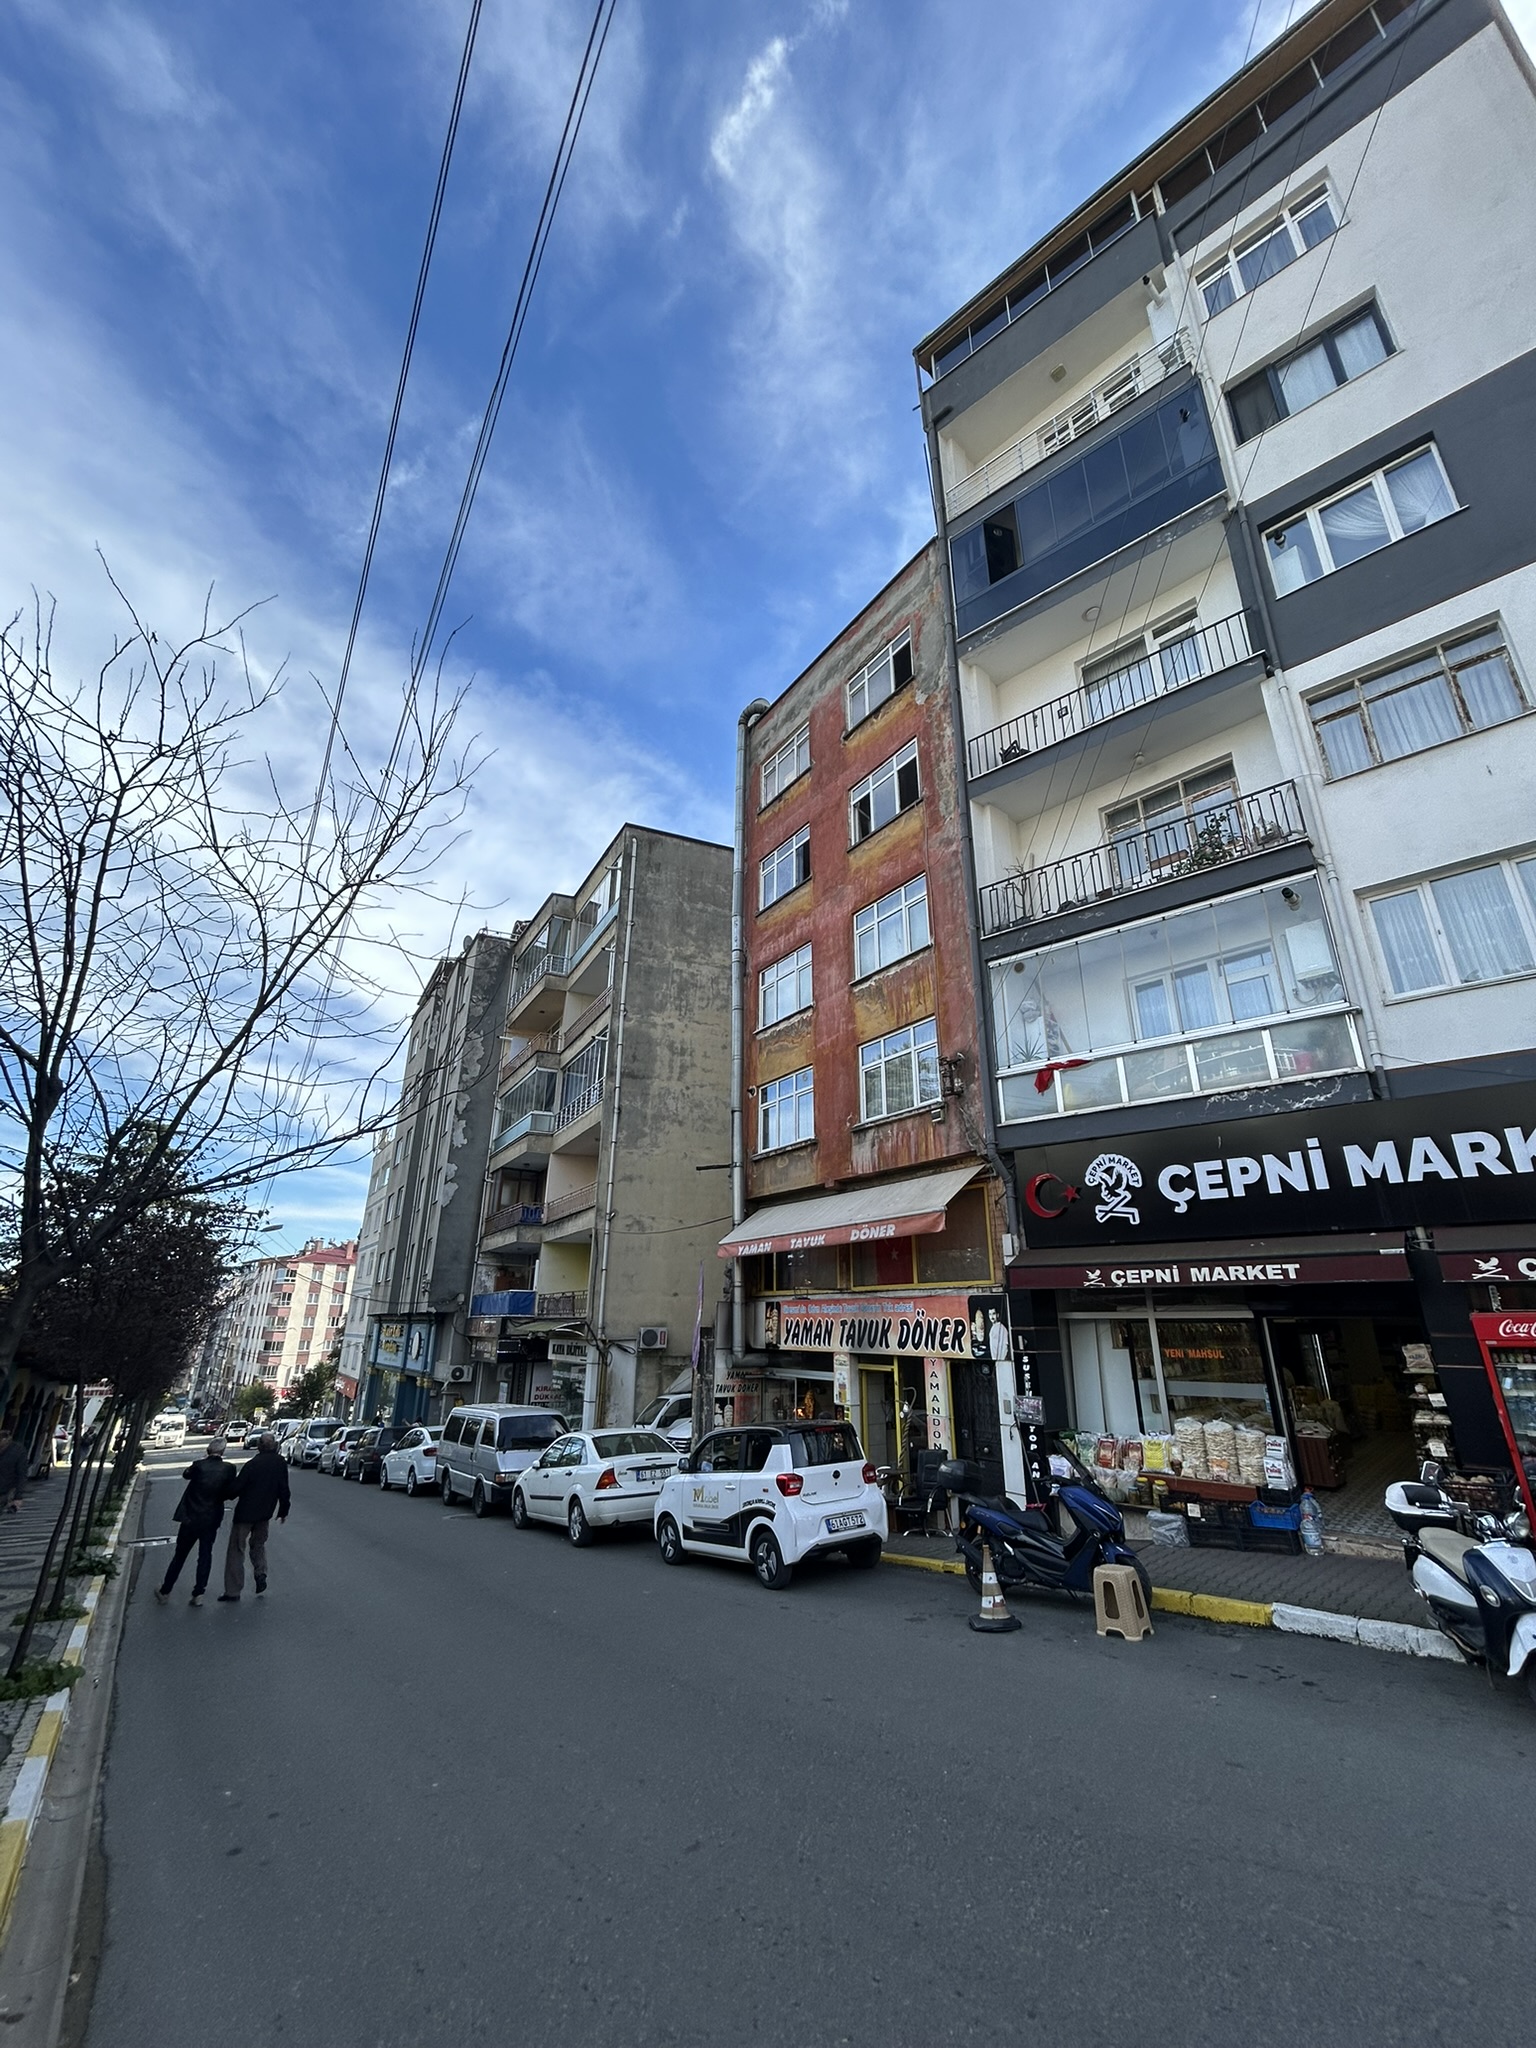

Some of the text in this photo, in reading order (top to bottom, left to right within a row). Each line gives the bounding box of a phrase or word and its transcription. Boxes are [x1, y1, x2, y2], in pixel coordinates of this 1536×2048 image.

[1108, 1157, 1140, 1185] MARKET
[1158, 1137, 1330, 1213] ÇEPNİ
[737, 1224, 896, 1255] YAMAN TAVUK DÖNER
[1110, 1264, 1300, 1287] ÇEPNİ MARKET
[783, 1309, 967, 1353] YAMAN TAVUK DÖNER
